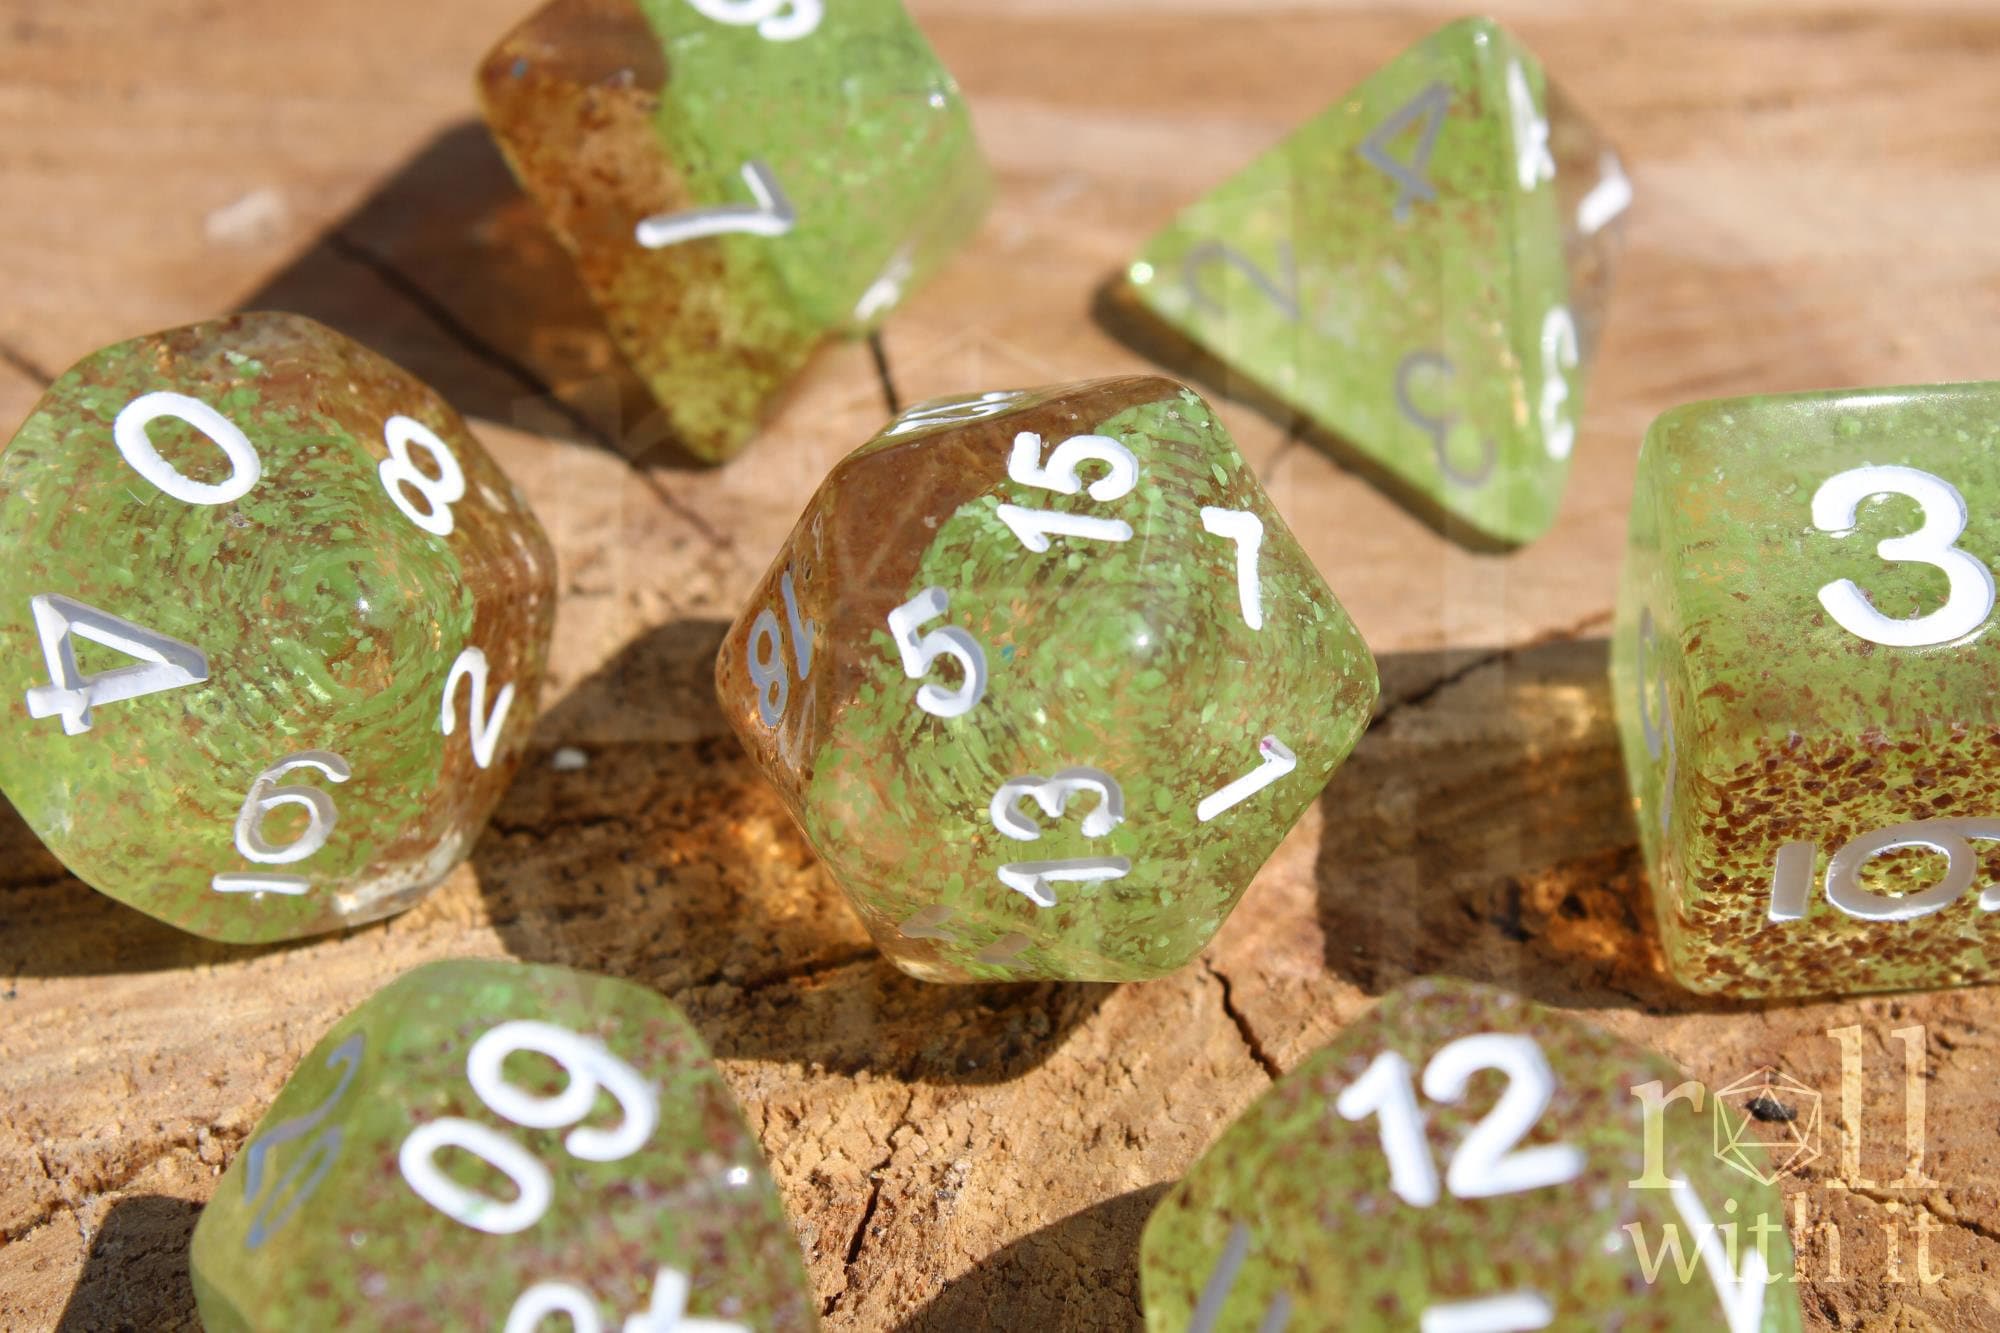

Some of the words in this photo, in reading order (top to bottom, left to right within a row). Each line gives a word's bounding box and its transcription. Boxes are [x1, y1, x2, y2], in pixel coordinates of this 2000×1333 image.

[1358, 80, 1455, 222] 4
[1183, 238, 1301, 325] 2
[113, 391, 261, 505] 0
[378, 414, 466, 537] 8
[1393, 350, 1497, 488] 3
[997, 431, 1139, 553] 15
[1811, 465, 1996, 647] 3
[1200, 506, 1263, 630] 7
[26, 592, 208, 737] 4
[442, 646, 515, 769] 2
[888, 586, 987, 717] 5
[990, 766, 1134, 907] 13
[1336, 1033, 1588, 1207] 12
